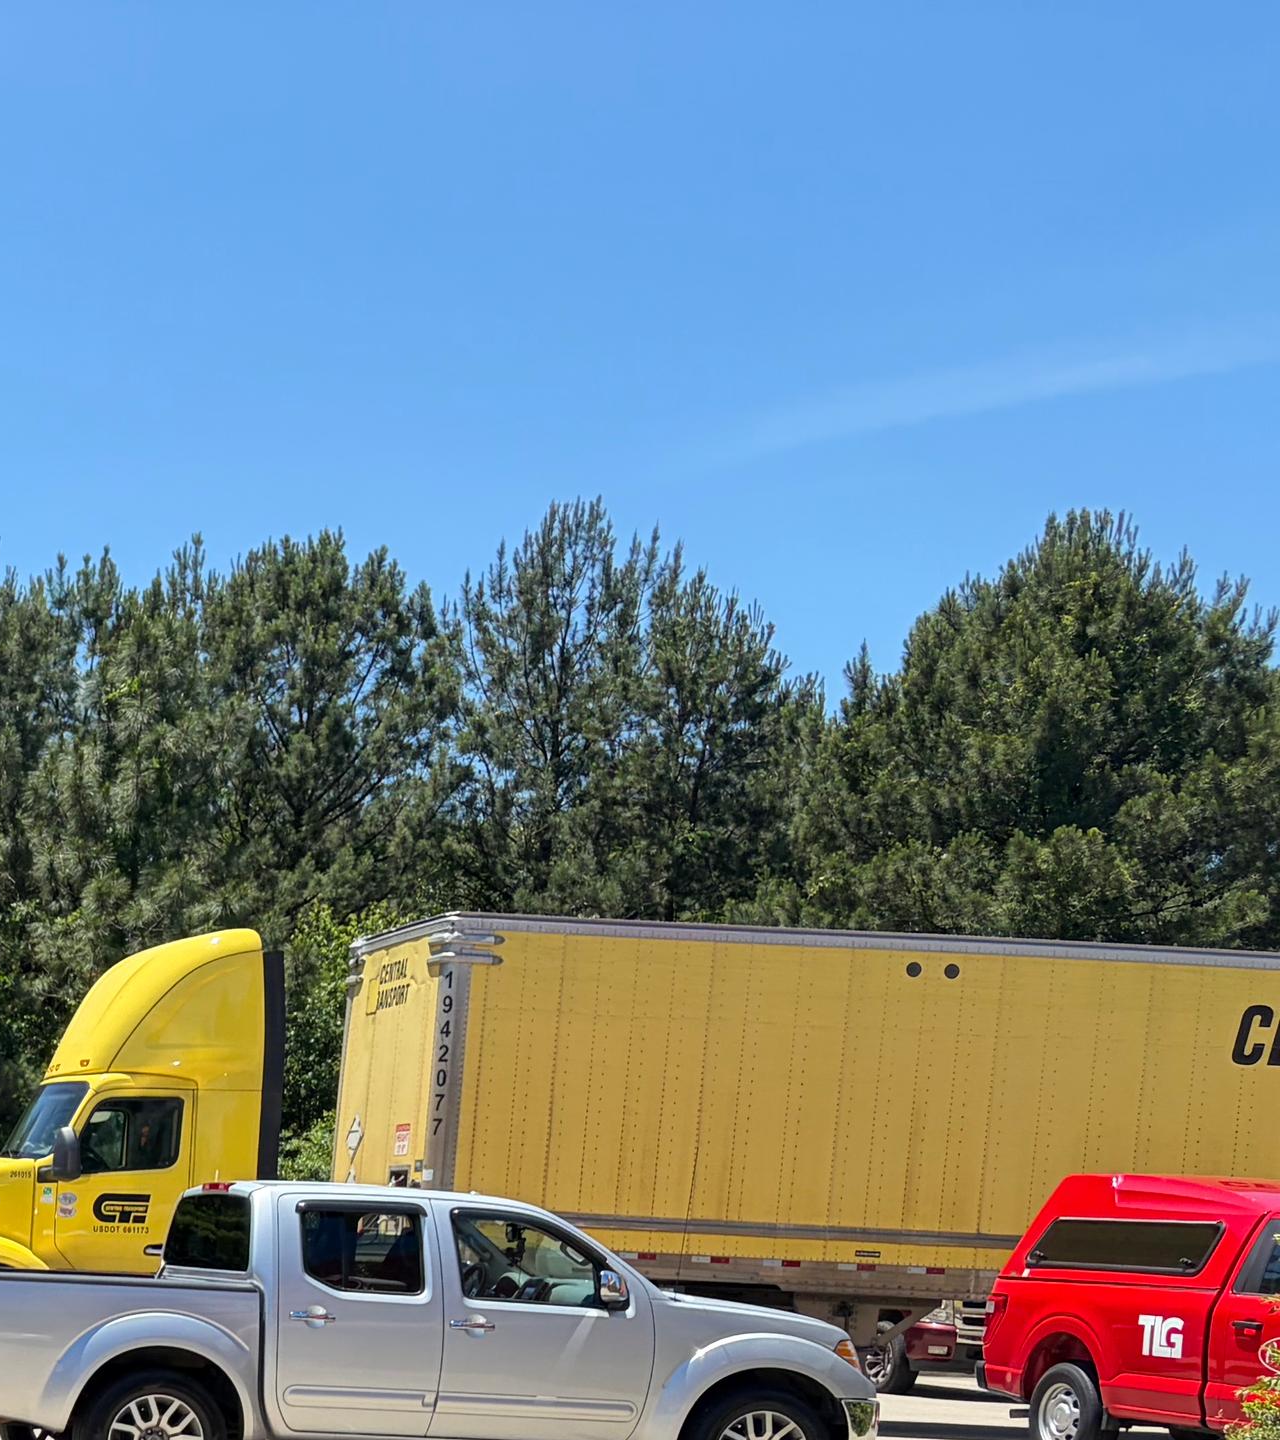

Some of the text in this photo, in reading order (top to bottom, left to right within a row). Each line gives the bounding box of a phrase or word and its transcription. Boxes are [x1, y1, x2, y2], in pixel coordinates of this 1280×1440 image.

[380, 958, 408, 984] CENTRAL
[433, 971, 454, 1135] 1942077
[1138, 1314, 1185, 1359] TLG
